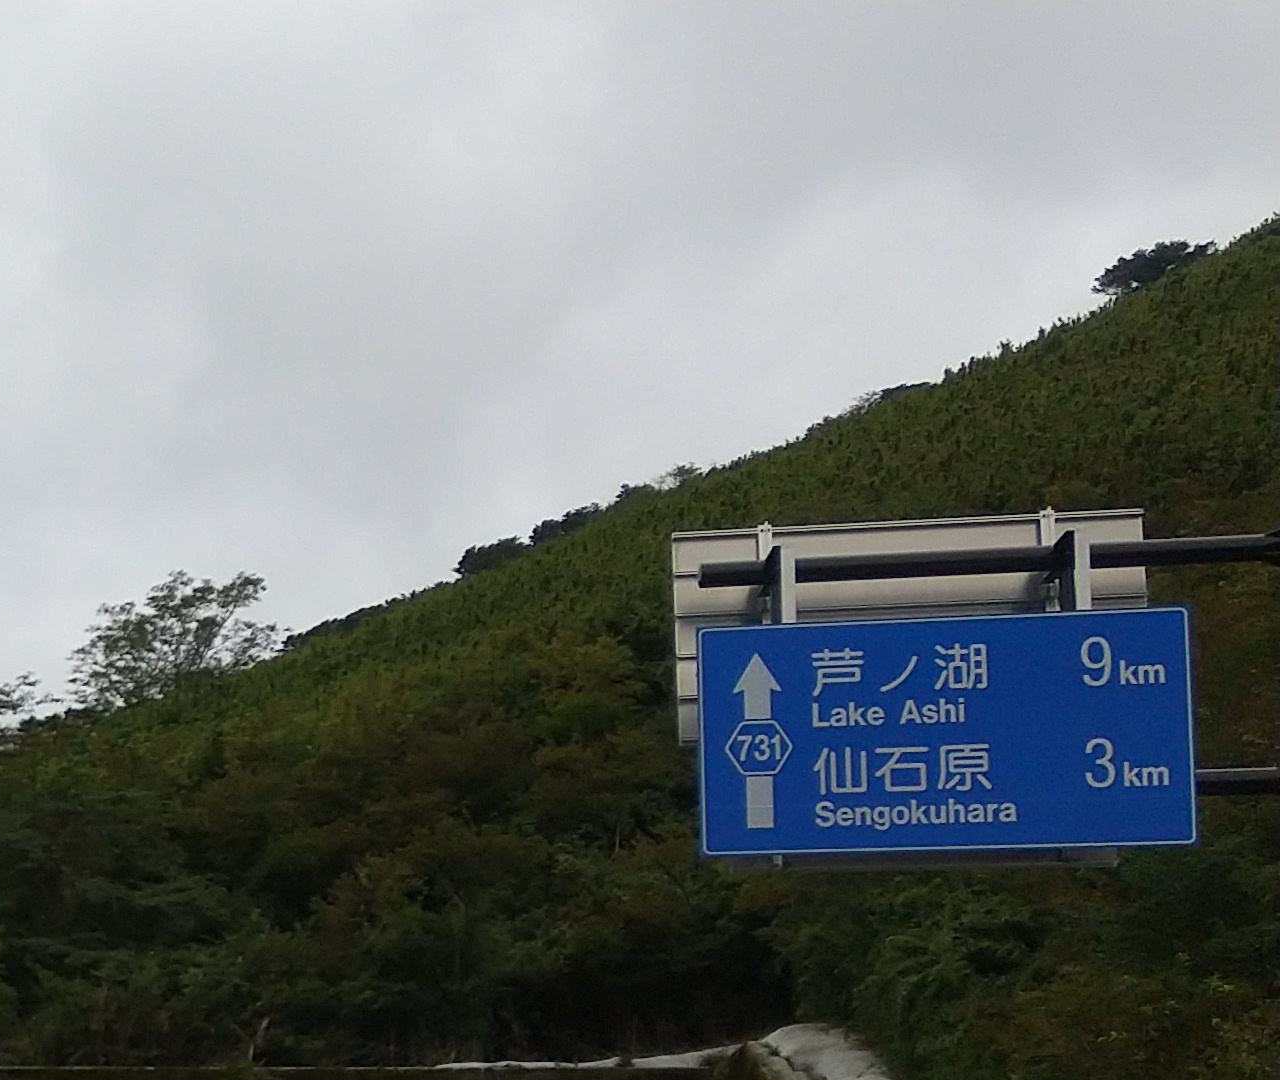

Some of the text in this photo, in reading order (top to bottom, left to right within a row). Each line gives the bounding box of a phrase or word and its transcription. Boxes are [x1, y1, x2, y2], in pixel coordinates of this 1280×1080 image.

[810, 643, 988, 696] 芦ノ湖
[812, 699, 965, 727] Lake Ashi
[737, 734, 785, 763] 731
[812, 744, 992, 796] 仙石原
[815, 799, 1017, 830] Sengokuhara
